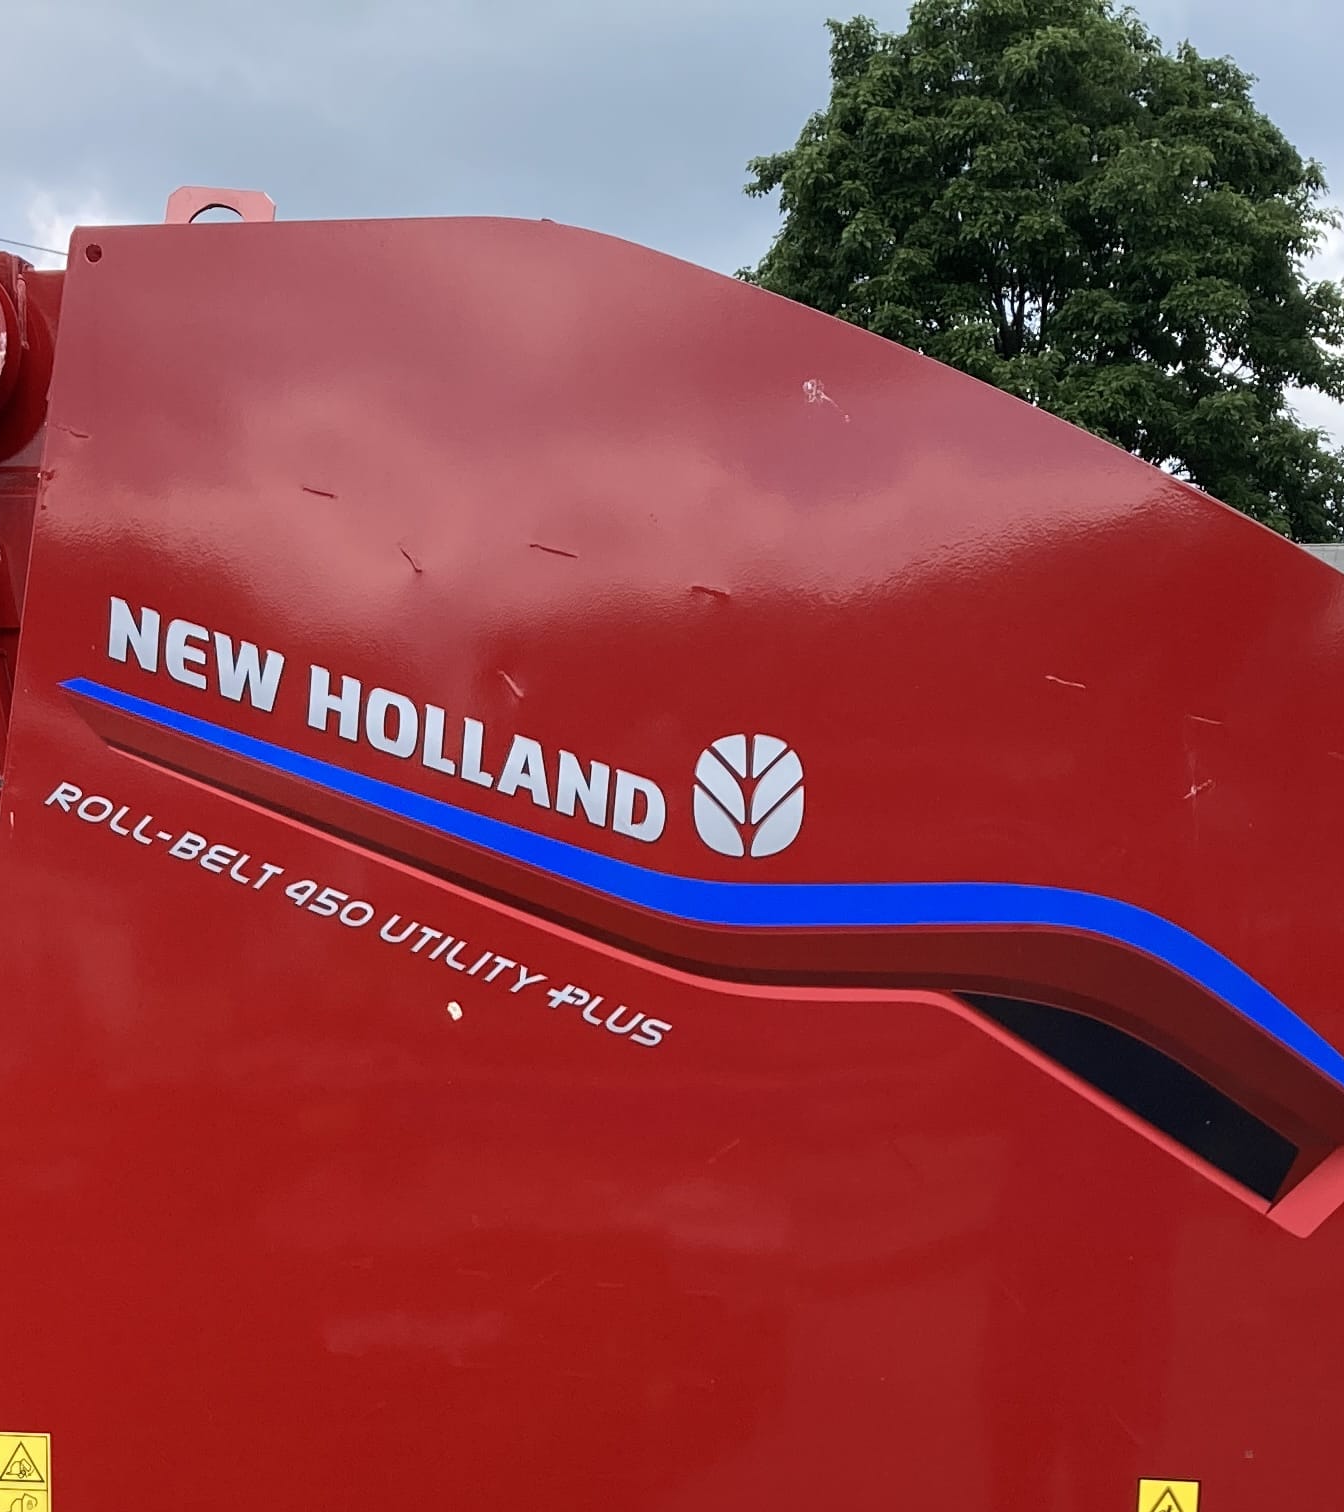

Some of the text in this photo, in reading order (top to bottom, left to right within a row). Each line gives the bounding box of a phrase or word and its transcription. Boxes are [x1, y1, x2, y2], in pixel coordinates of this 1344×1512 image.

[108, 596, 667, 843] NEW HOLLAND
[43, 780, 286, 891] ROLL-BELT
[284, 879, 376, 928] 450
[379, 913, 548, 994] UTILITY
